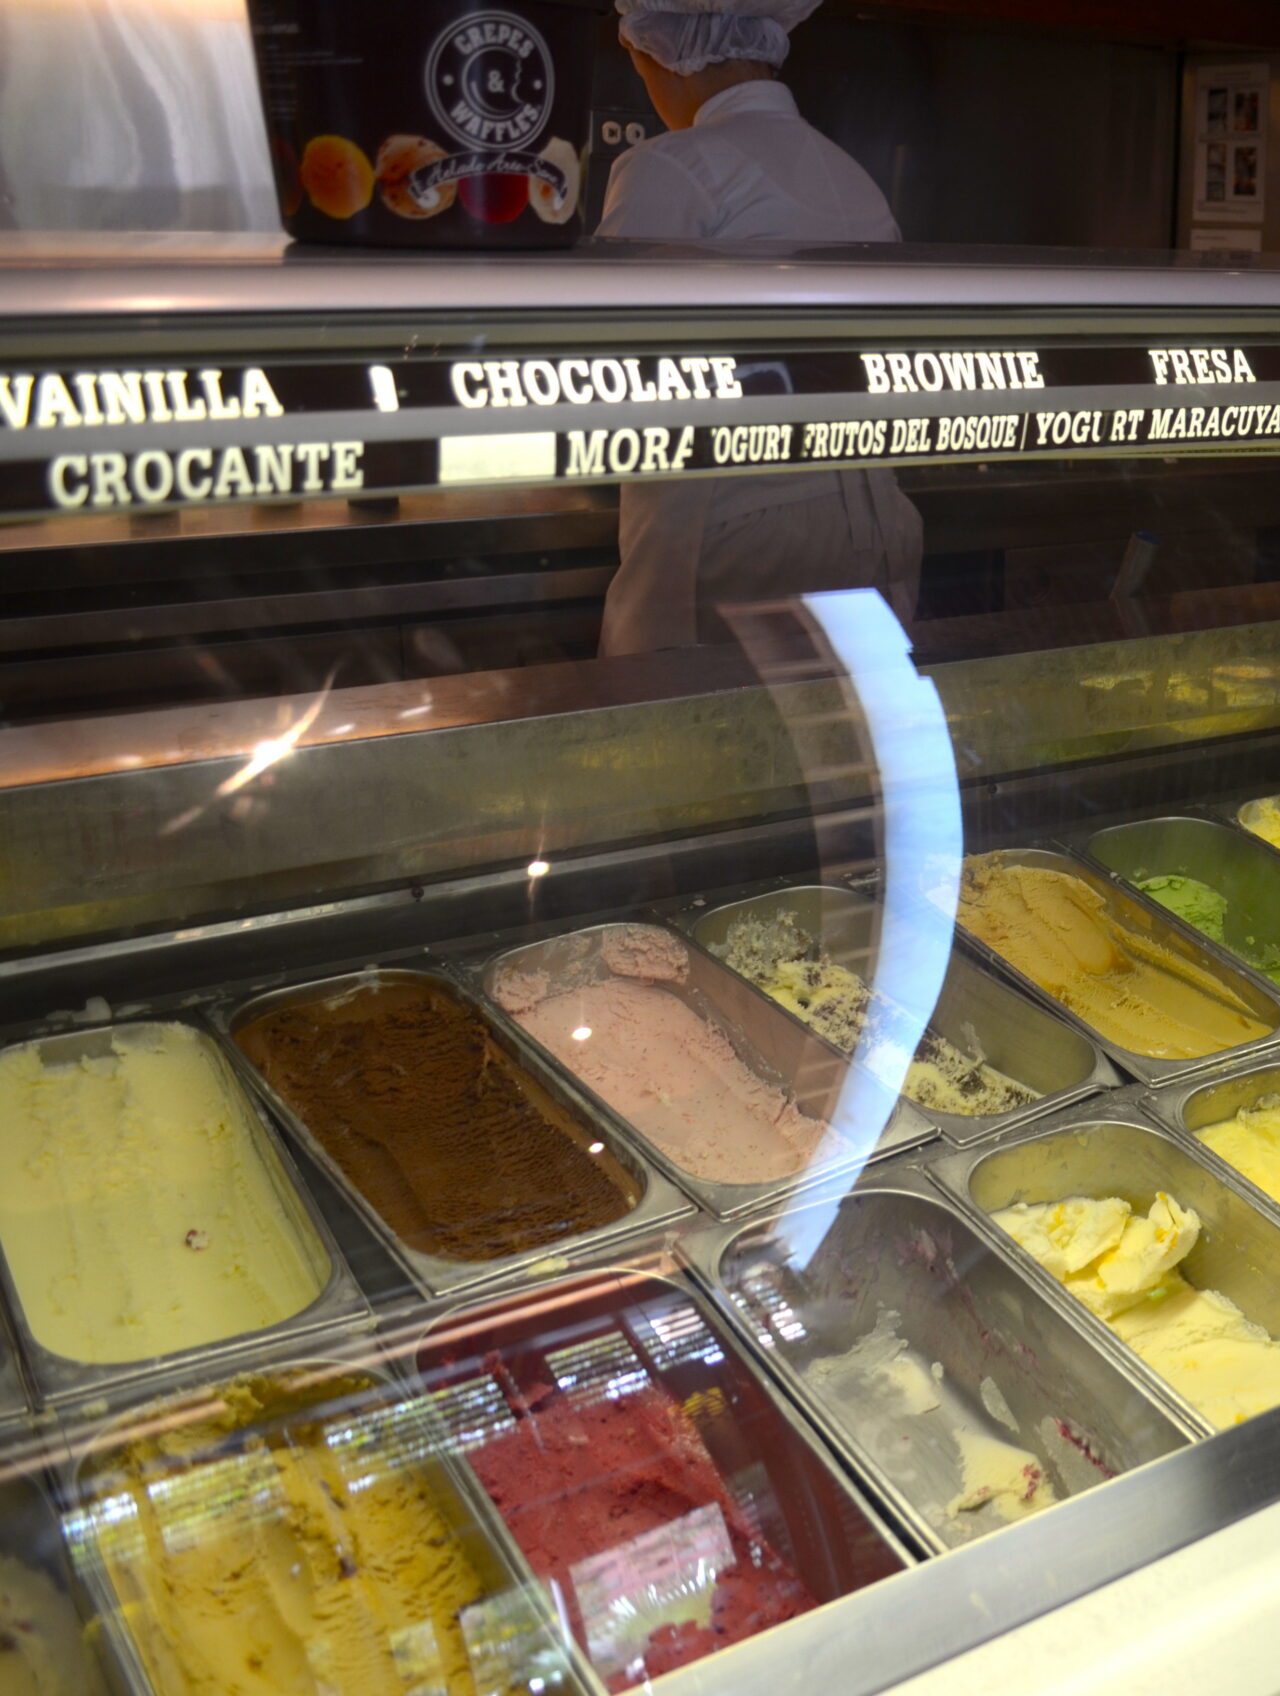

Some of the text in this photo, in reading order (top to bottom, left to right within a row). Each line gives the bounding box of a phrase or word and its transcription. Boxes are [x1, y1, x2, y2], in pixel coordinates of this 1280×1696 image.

[453, 22, 535, 59] CREPES
[487, 69, 505, 94] &
[450, 99, 541, 143] WAFFLES
[452, 357, 744, 408] CHOCOLATE
[860, 351, 1045, 395] BROWNIE
[1148, 348, 1257, 386] FRESA
[0, 368, 284, 428] VAINILLA
[566, 424, 696, 476] MORA
[710, 414, 1019, 465] OGURT FRUTOS DEL BOSQUE
[49, 440, 365, 509] CROCANTE
